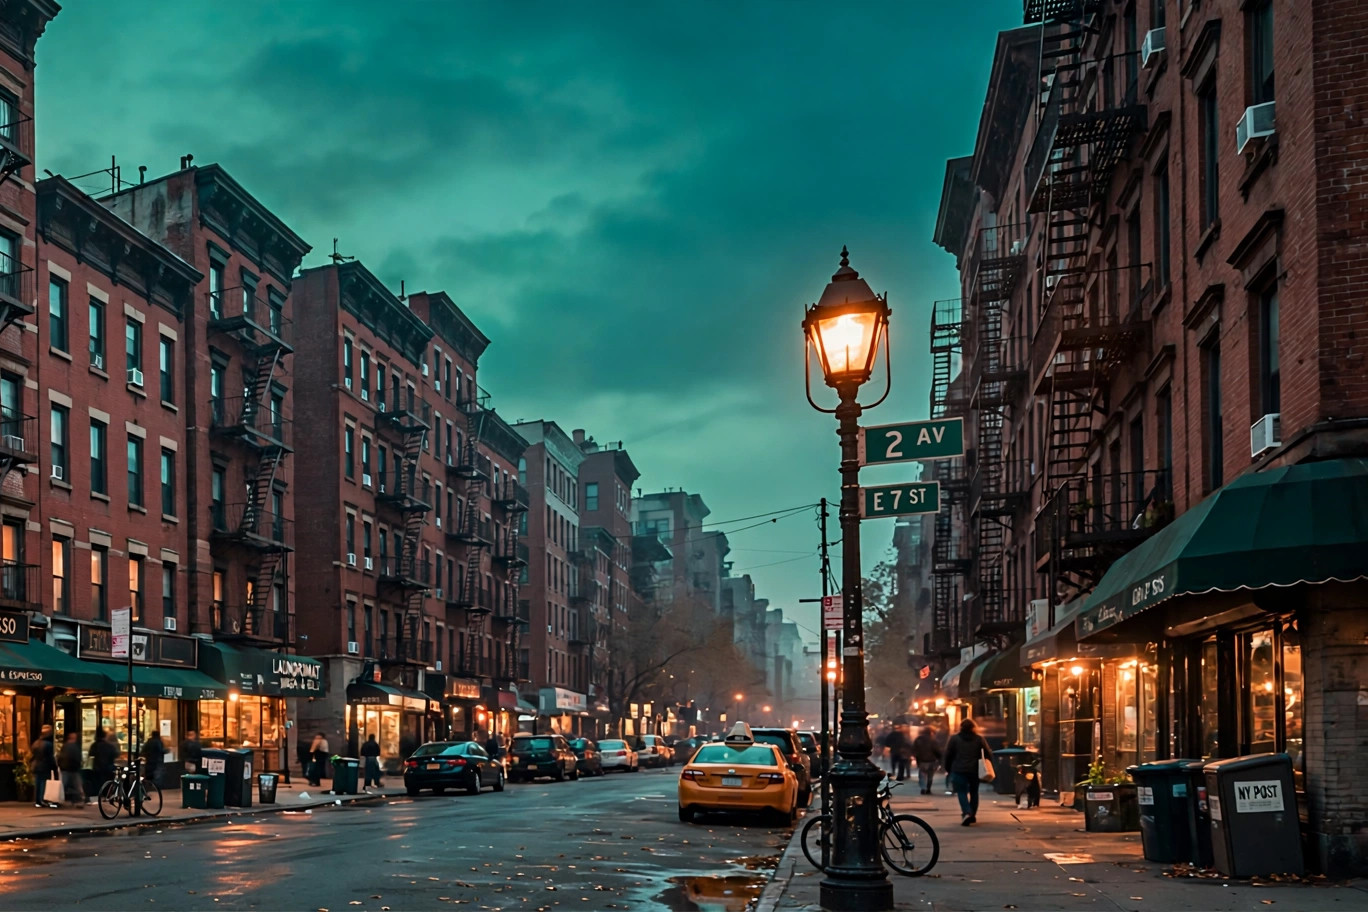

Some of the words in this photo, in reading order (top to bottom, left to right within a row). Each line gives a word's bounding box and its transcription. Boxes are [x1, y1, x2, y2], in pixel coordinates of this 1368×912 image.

[885, 430, 903, 458] 2
[916, 426, 946, 446] AV
[873, 492, 884, 511] E
[890, 490, 902, 510] 7
[909, 488, 926, 504] ST
[1238, 785, 1251, 800] NY
[1253, 784, 1278, 800] POST
